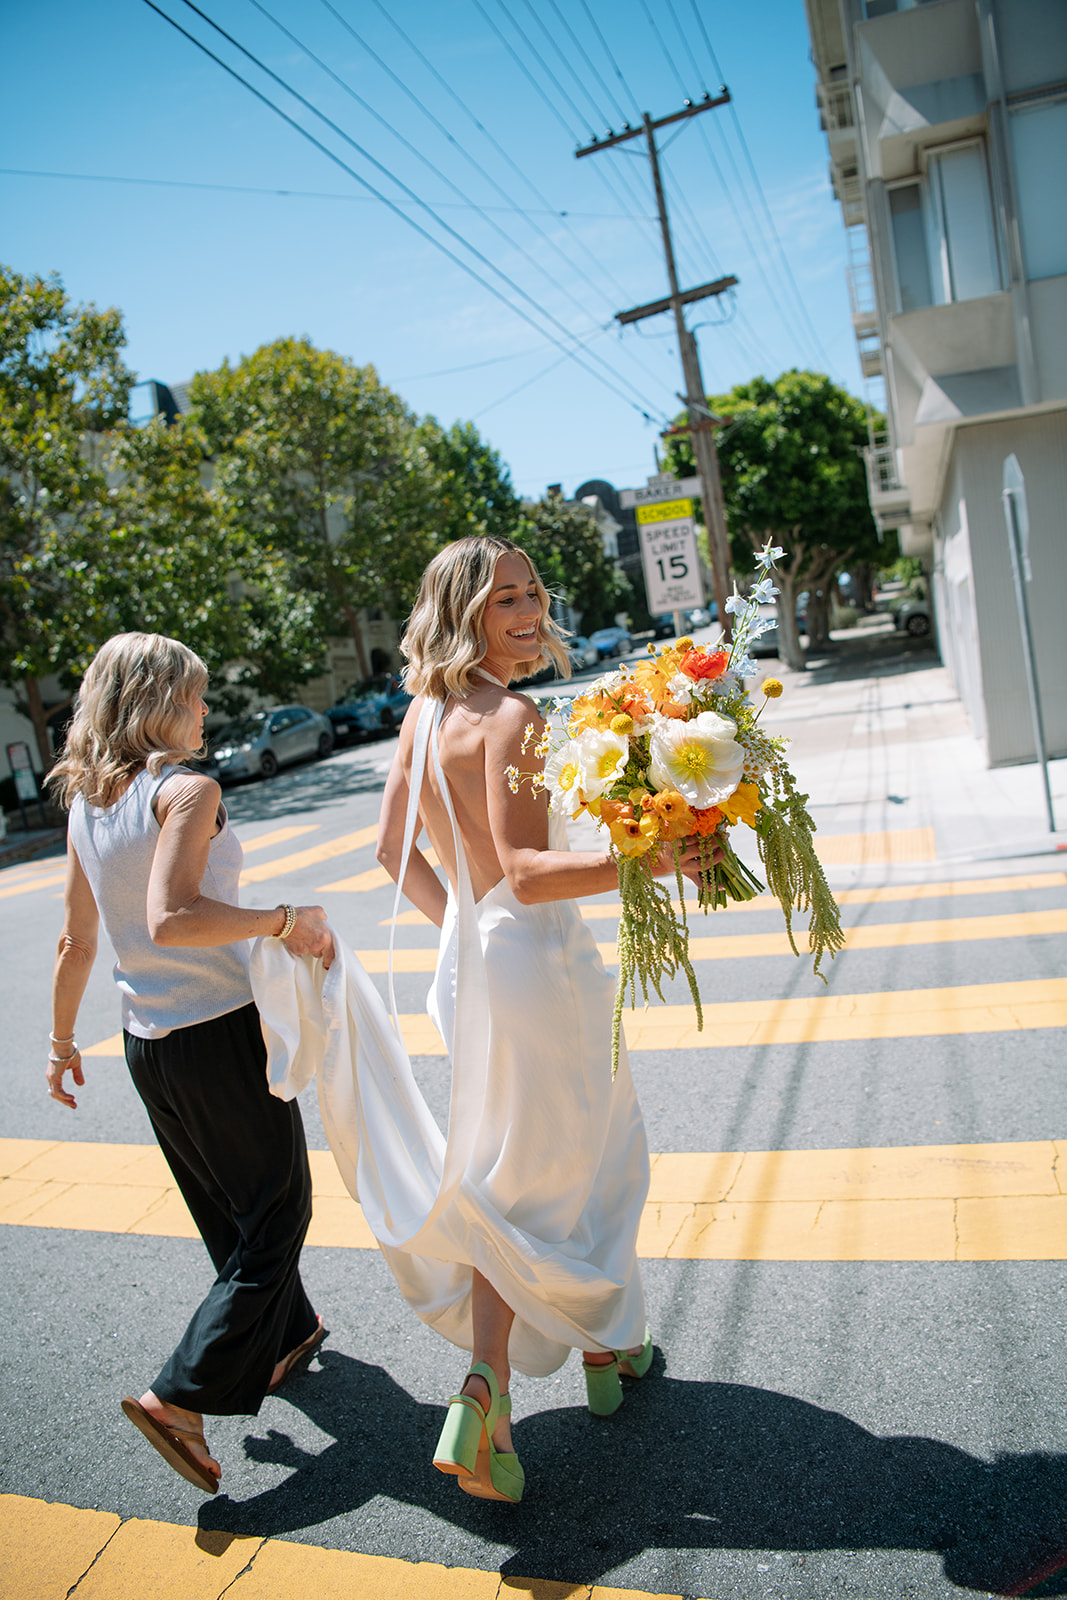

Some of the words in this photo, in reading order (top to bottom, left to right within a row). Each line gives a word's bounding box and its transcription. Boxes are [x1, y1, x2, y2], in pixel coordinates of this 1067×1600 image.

[635, 484, 682, 501] BAKER
[640, 504, 688, 520] SCHOOL
[646, 525, 690, 542] SPEED
[651, 540, 686, 556] LIMIT
[656, 555, 689, 581] 15
